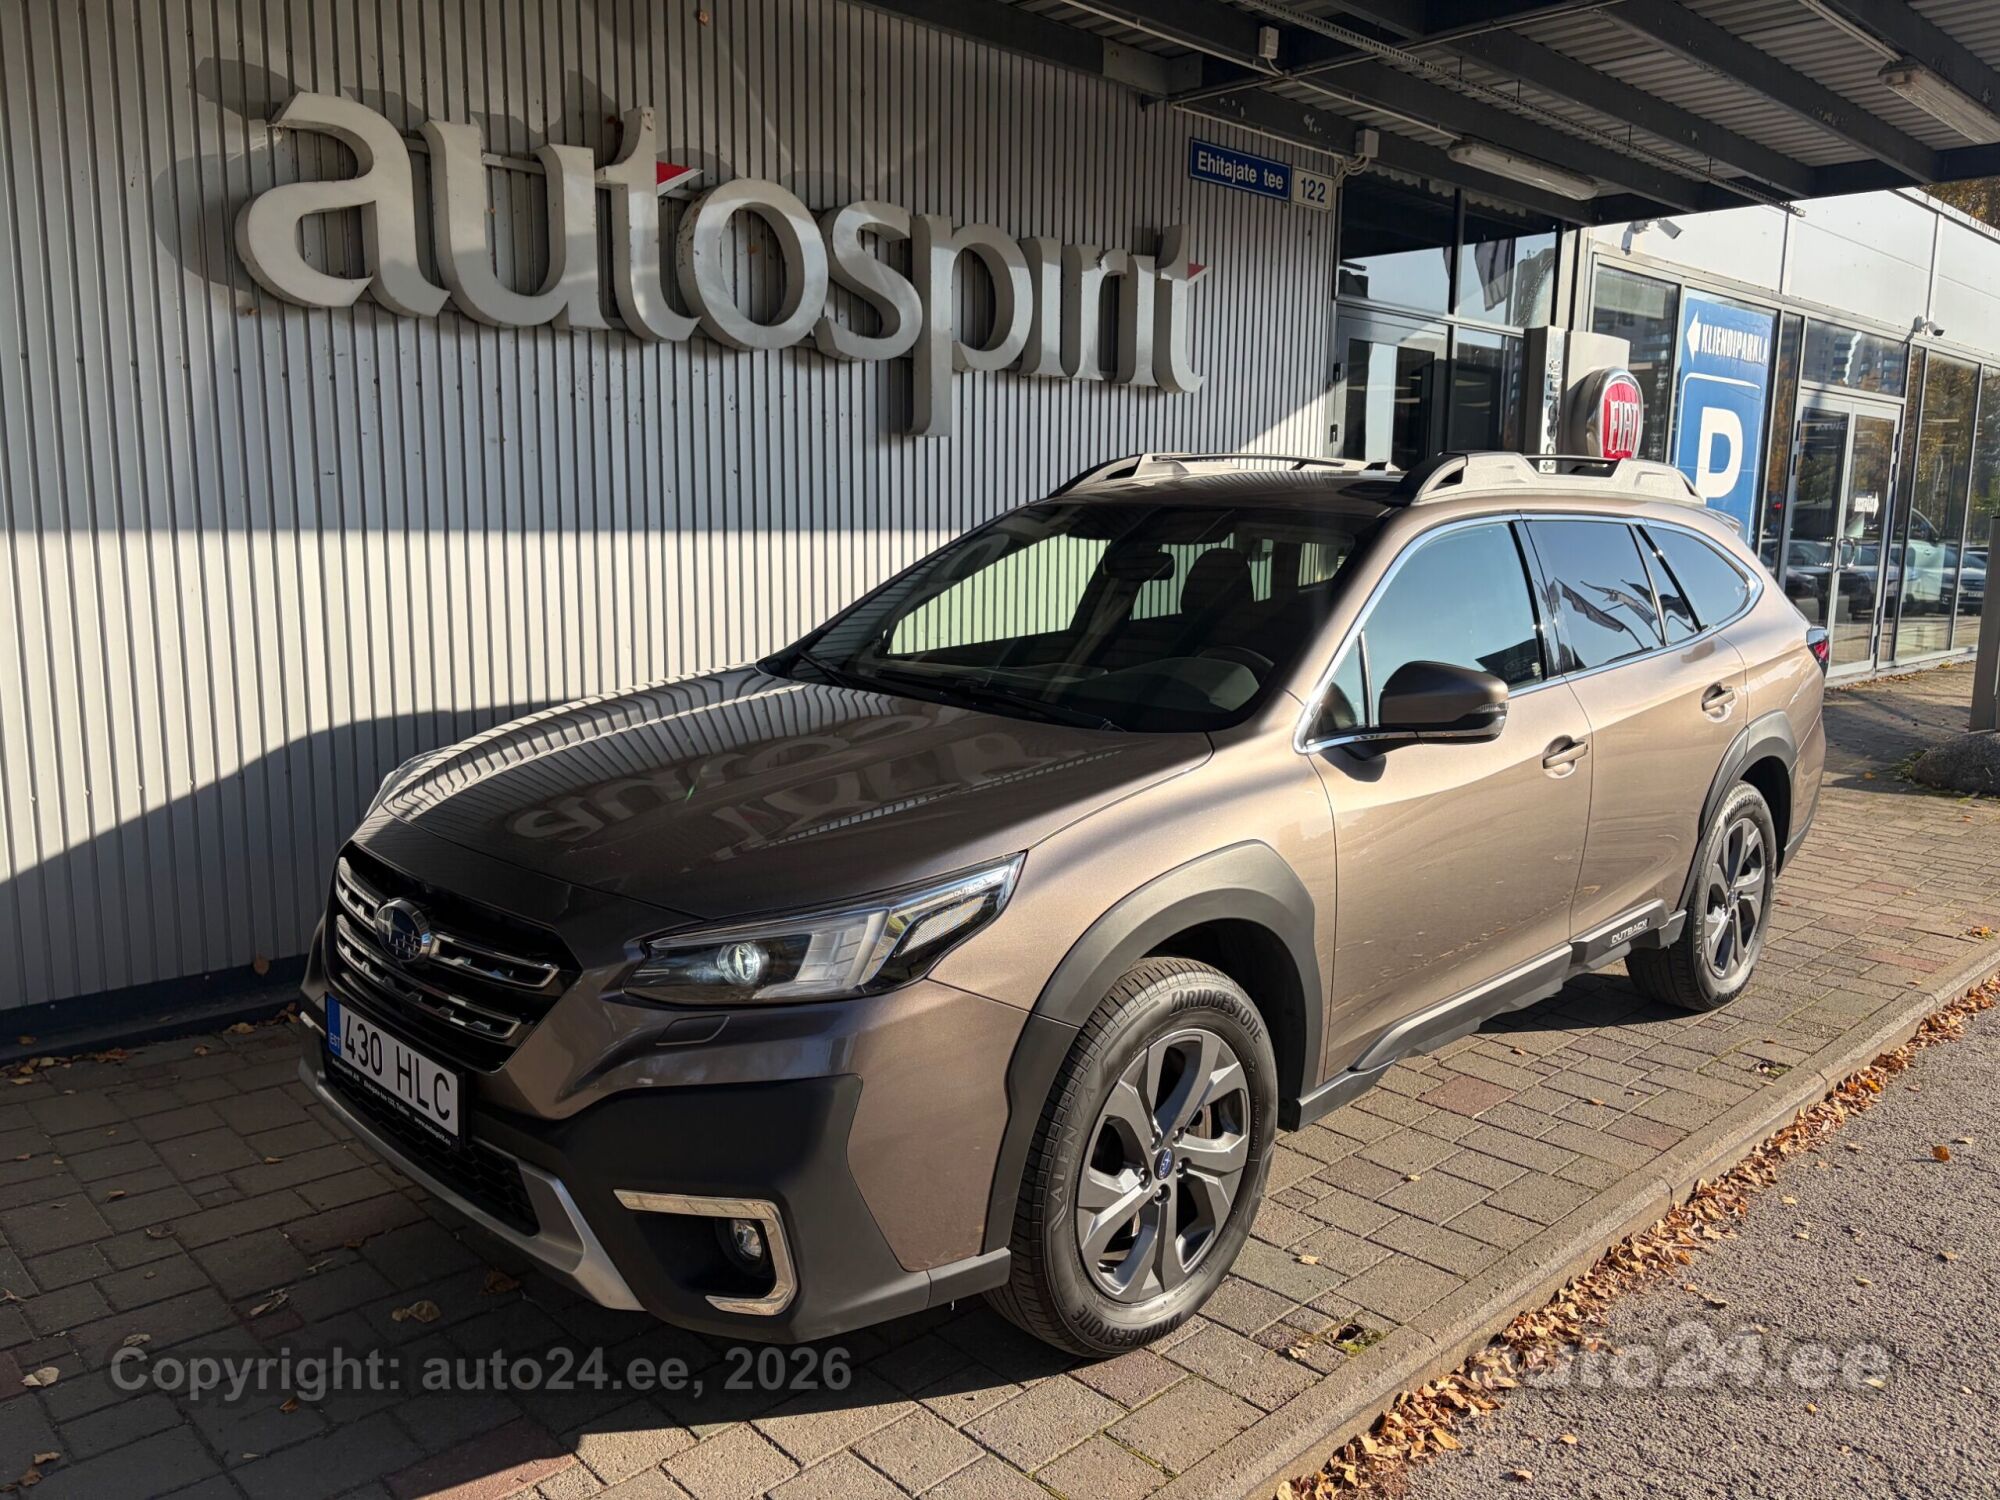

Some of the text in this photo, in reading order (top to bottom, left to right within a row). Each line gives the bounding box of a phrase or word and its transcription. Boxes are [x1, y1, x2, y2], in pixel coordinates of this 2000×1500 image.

[1197, 151, 1284, 190] Ehitajate tee
[1301, 177, 1326, 203] 122
[234, 91, 1206, 438] autospirit
[1701, 323, 1768, 365] KLIENDIPARKLA
[1608, 400, 1640, 452] FIAT
[1695, 406, 1743, 504] P
[1611, 918, 1649, 944] OUTBACK
[329, 1032, 341, 1049] EST
[1170, 989, 1264, 1044] BRIDGESTONE
[345, 1015, 450, 1121] 430 HLC
[1051, 1087, 1096, 1202] ALENZA
